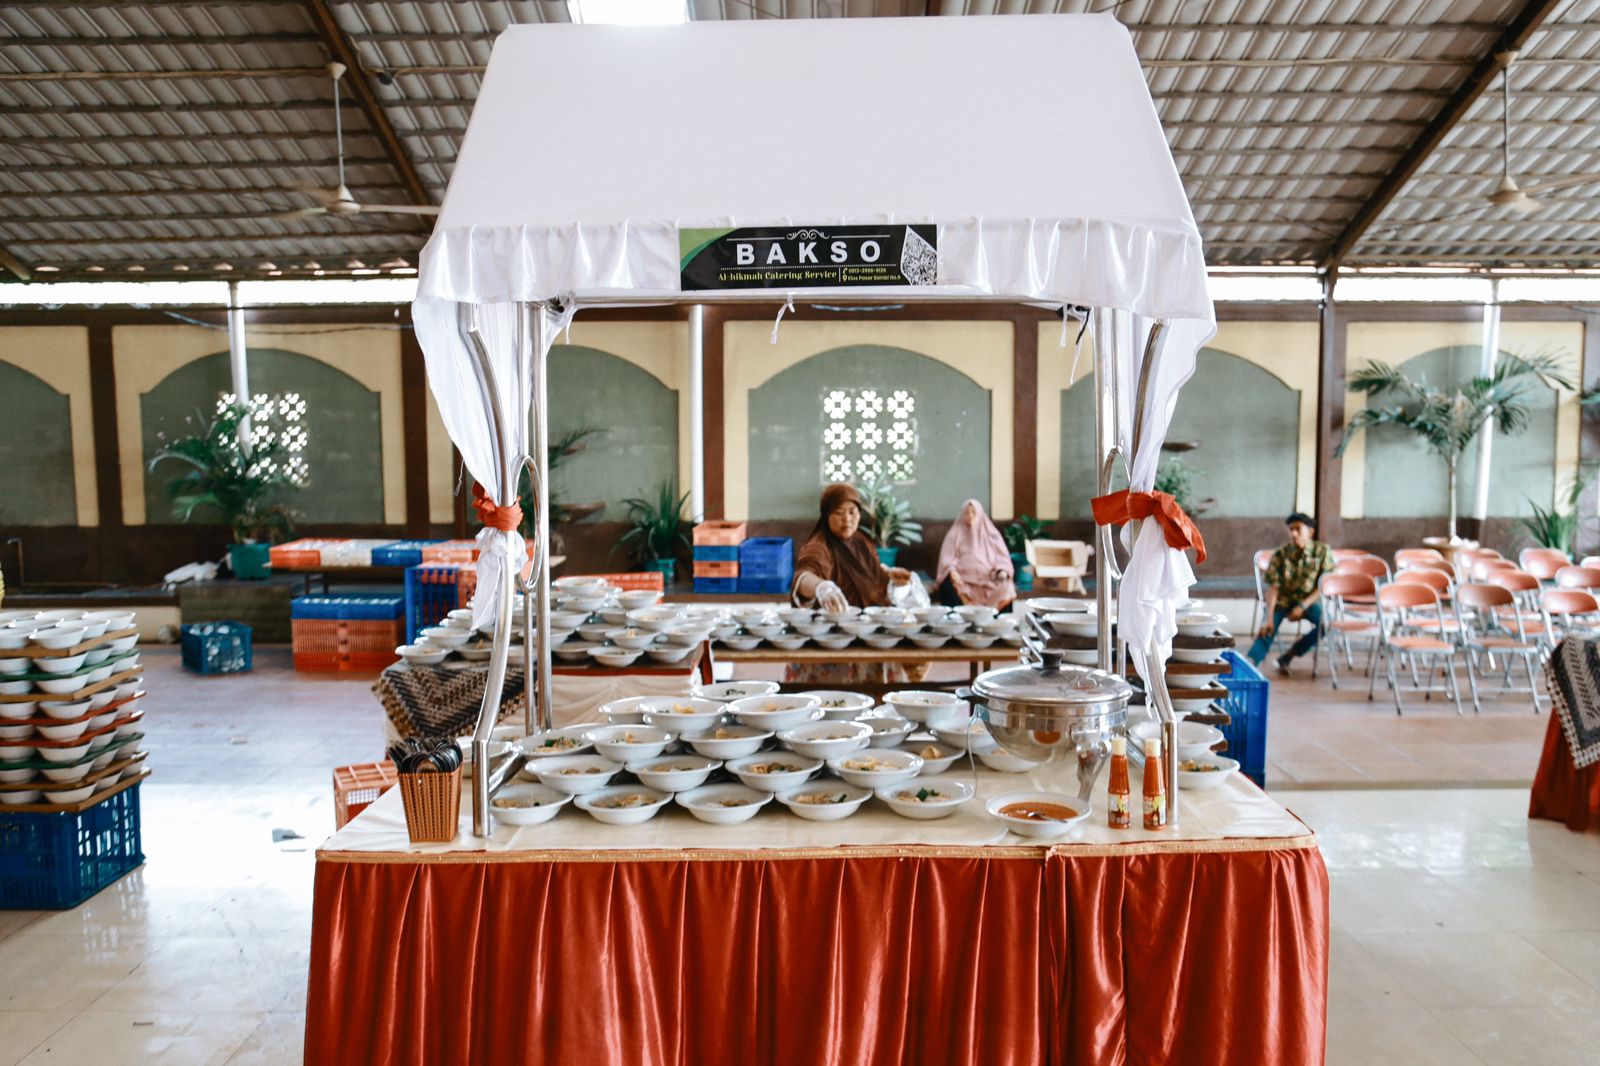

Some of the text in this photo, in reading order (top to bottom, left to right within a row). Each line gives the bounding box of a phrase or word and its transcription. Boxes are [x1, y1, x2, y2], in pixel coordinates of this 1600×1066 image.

[736, 240, 881, 266] BAKSO
[718, 270, 836, 280] Al-hikmah Catering Service
